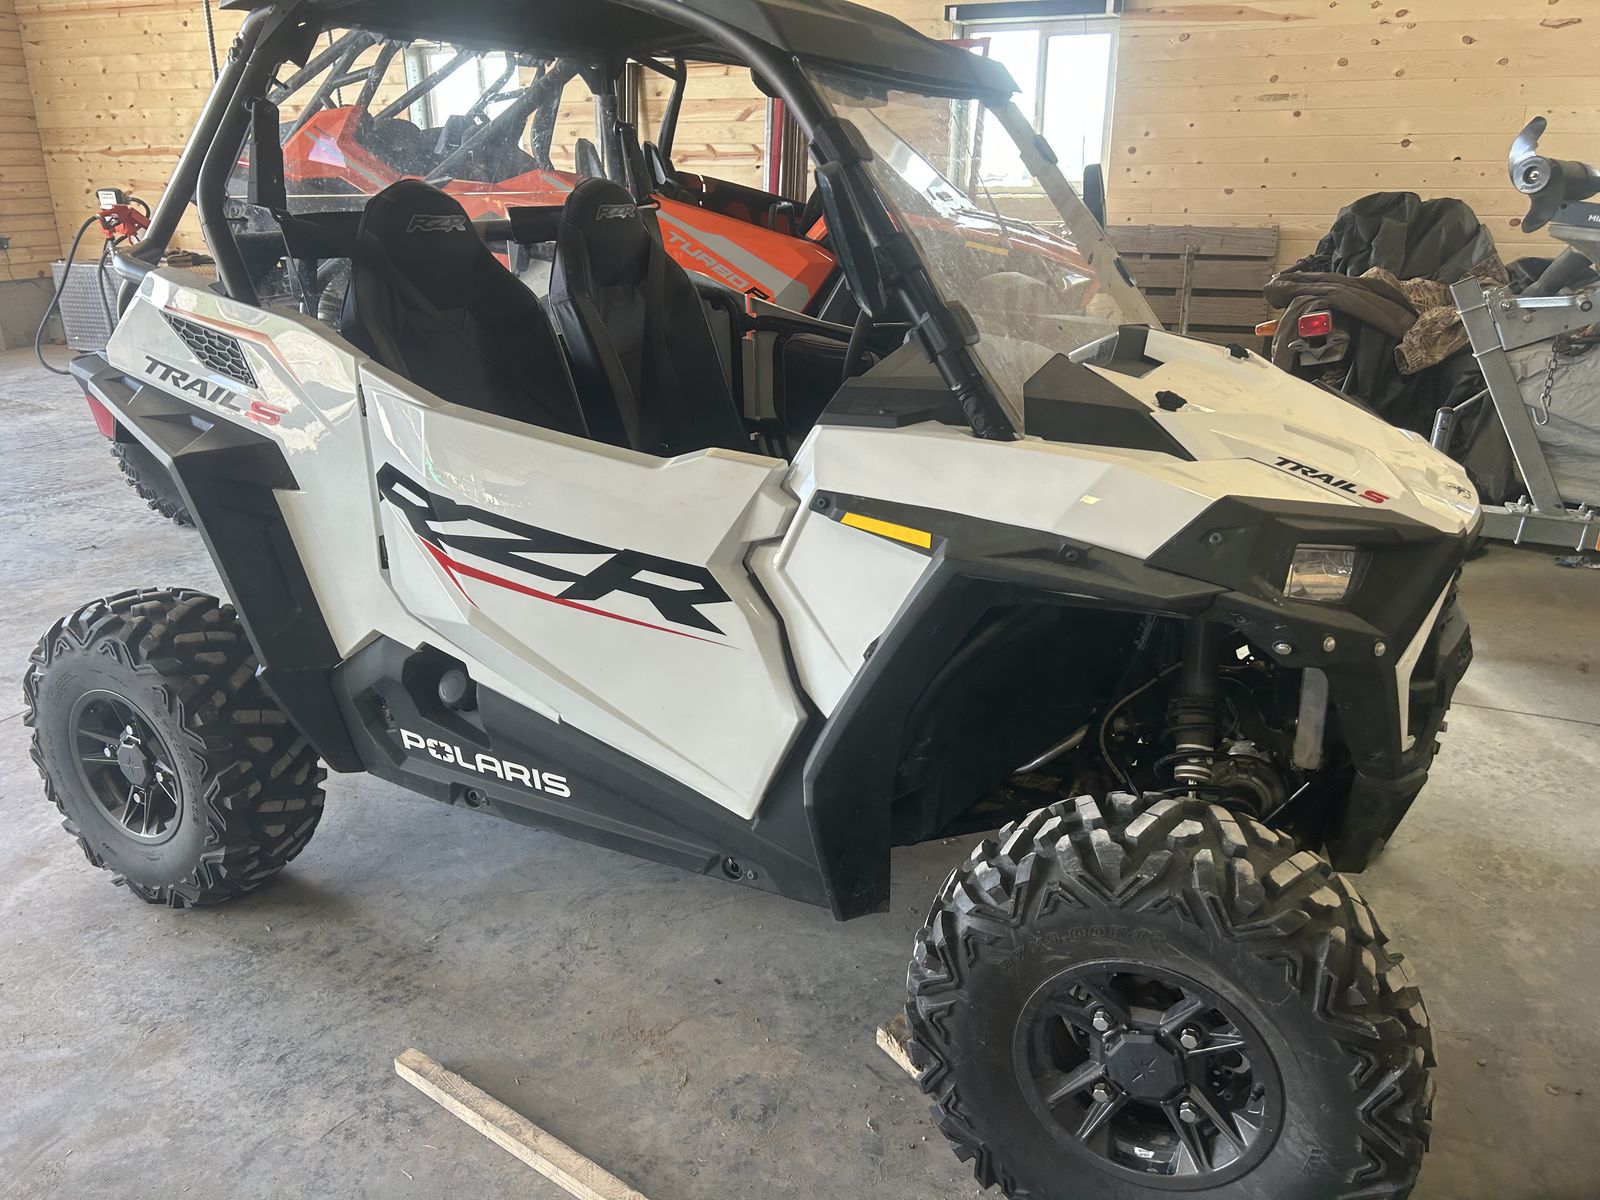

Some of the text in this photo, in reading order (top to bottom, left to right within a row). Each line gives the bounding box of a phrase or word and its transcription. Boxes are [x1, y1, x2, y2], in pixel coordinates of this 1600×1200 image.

[407, 214, 466, 232] RZR
[596, 204, 636, 221] RZR
[1587, 213, 1600, 223] MI
[668, 230, 750, 290] TURBO
[145, 355, 289, 426] TRAIL S
[1274, 456, 1390, 504] TRAIL S
[376, 462, 733, 636] RZR
[400, 728, 571, 798] POLARIS
